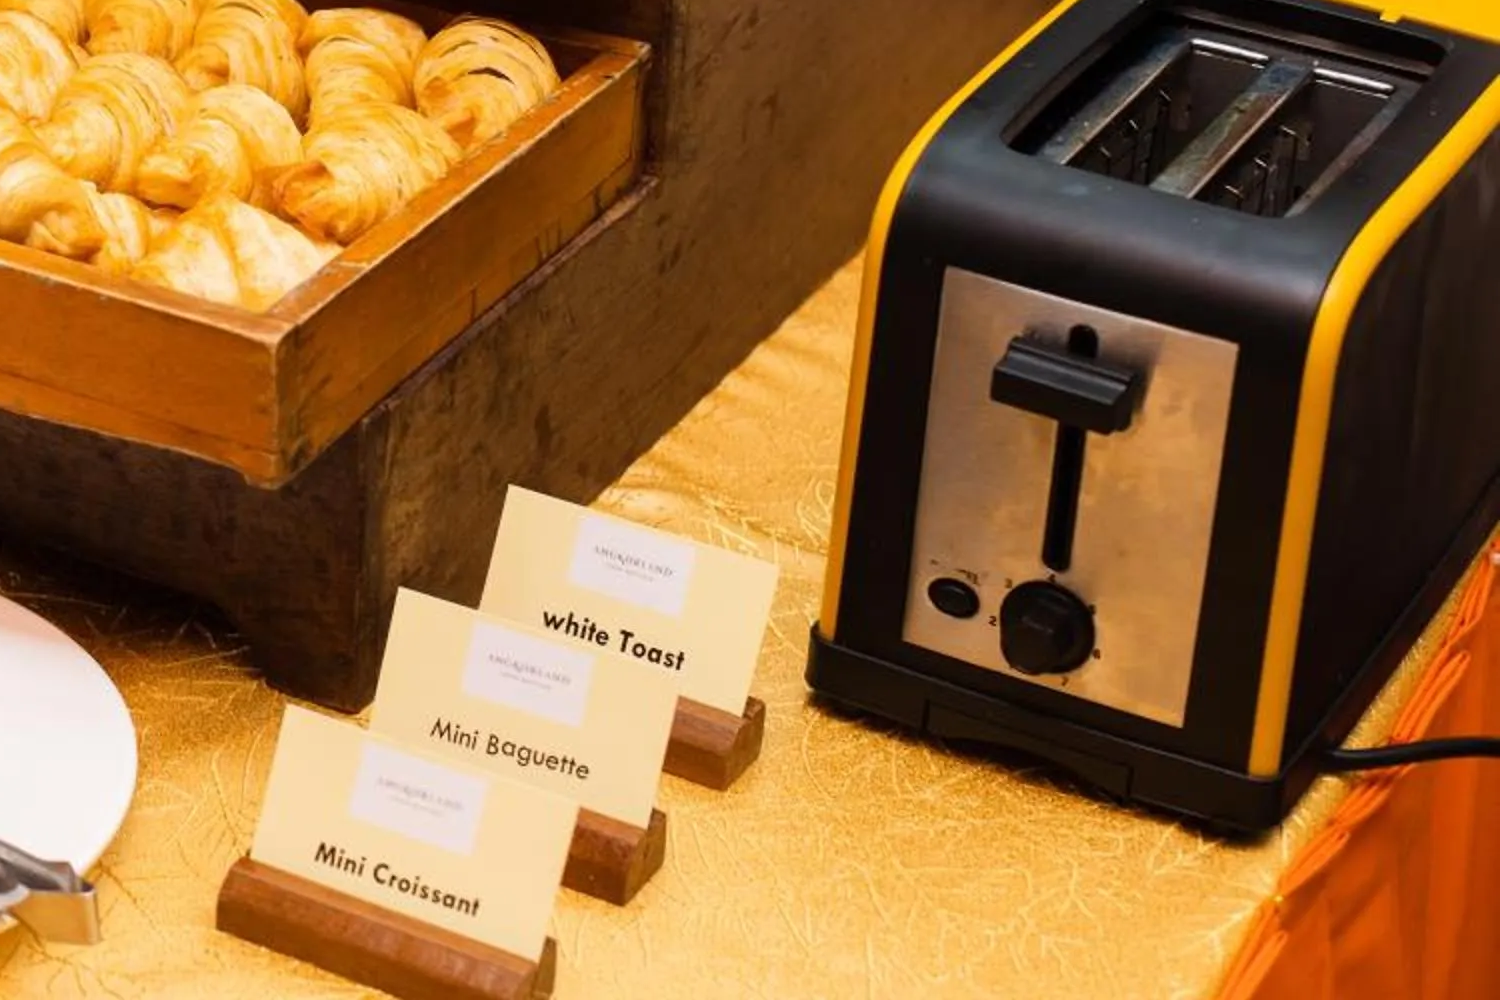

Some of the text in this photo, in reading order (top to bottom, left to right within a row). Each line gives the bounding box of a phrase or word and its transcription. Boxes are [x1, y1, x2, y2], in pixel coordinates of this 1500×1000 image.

[543, 611, 686, 671] white Toast
[430, 718, 590, 780] Mini Baguette
[314, 842, 481, 917] Mini Croissant
